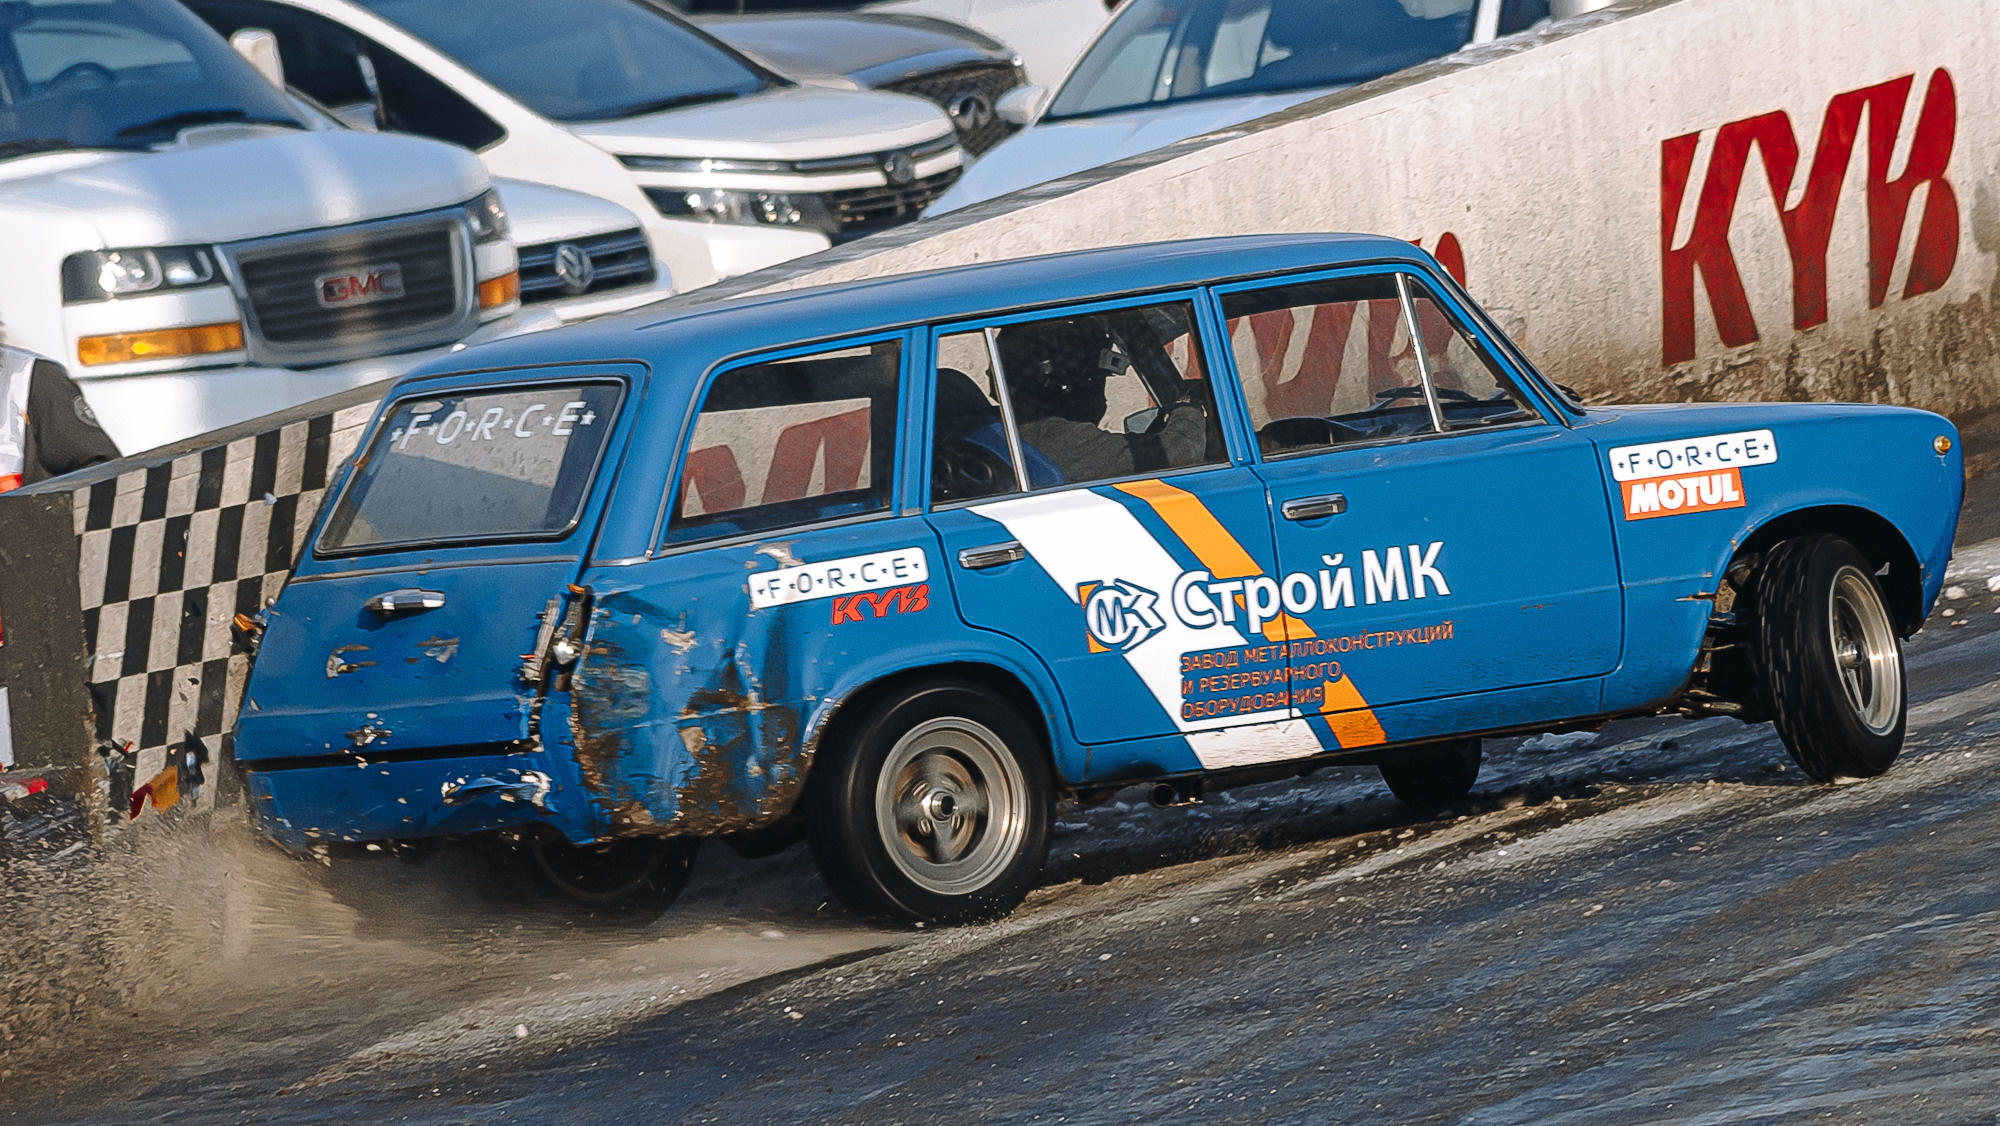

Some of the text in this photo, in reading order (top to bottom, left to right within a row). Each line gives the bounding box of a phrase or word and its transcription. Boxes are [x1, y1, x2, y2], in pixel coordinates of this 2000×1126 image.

[1661, 66, 1960, 368] KYB
[322, 268, 402, 303] GMC
[1629, 473, 1740, 515] MOTUL
[831, 584, 931, 625] KYB
[1181, 620, 1454, 674] ЗАВОД МЕТАЛЛОКОНСТРУКЦИЙ
[1181, 660, 1342, 695] И РЕЗЕРВУАРНОГО
[1181, 686, 1325, 720] ОБОРУДОВАНИЯ
